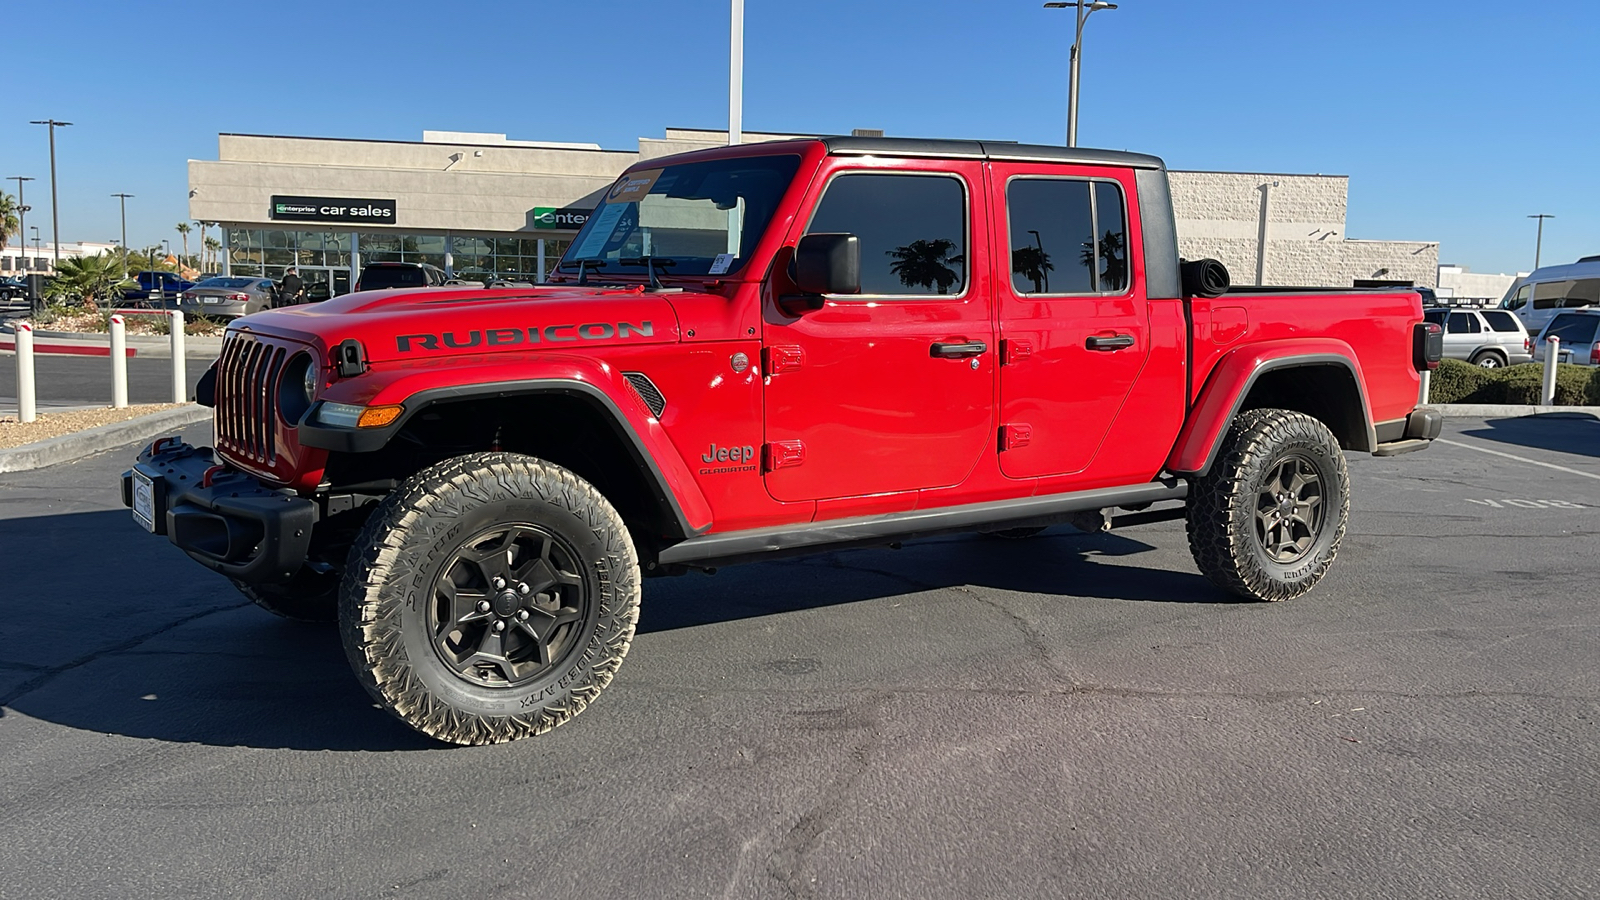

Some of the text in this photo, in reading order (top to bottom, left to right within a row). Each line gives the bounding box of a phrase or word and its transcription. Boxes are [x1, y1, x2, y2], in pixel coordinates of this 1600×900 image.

[279, 204, 392, 217] enterprise car sales
[396, 320, 655, 353] RUBICON
[701, 443, 755, 465] Jeep
[699, 465, 757, 475] GLADIATOR
[594, 556, 613, 620] TERRA
[557, 622, 608, 691] RAIDER
